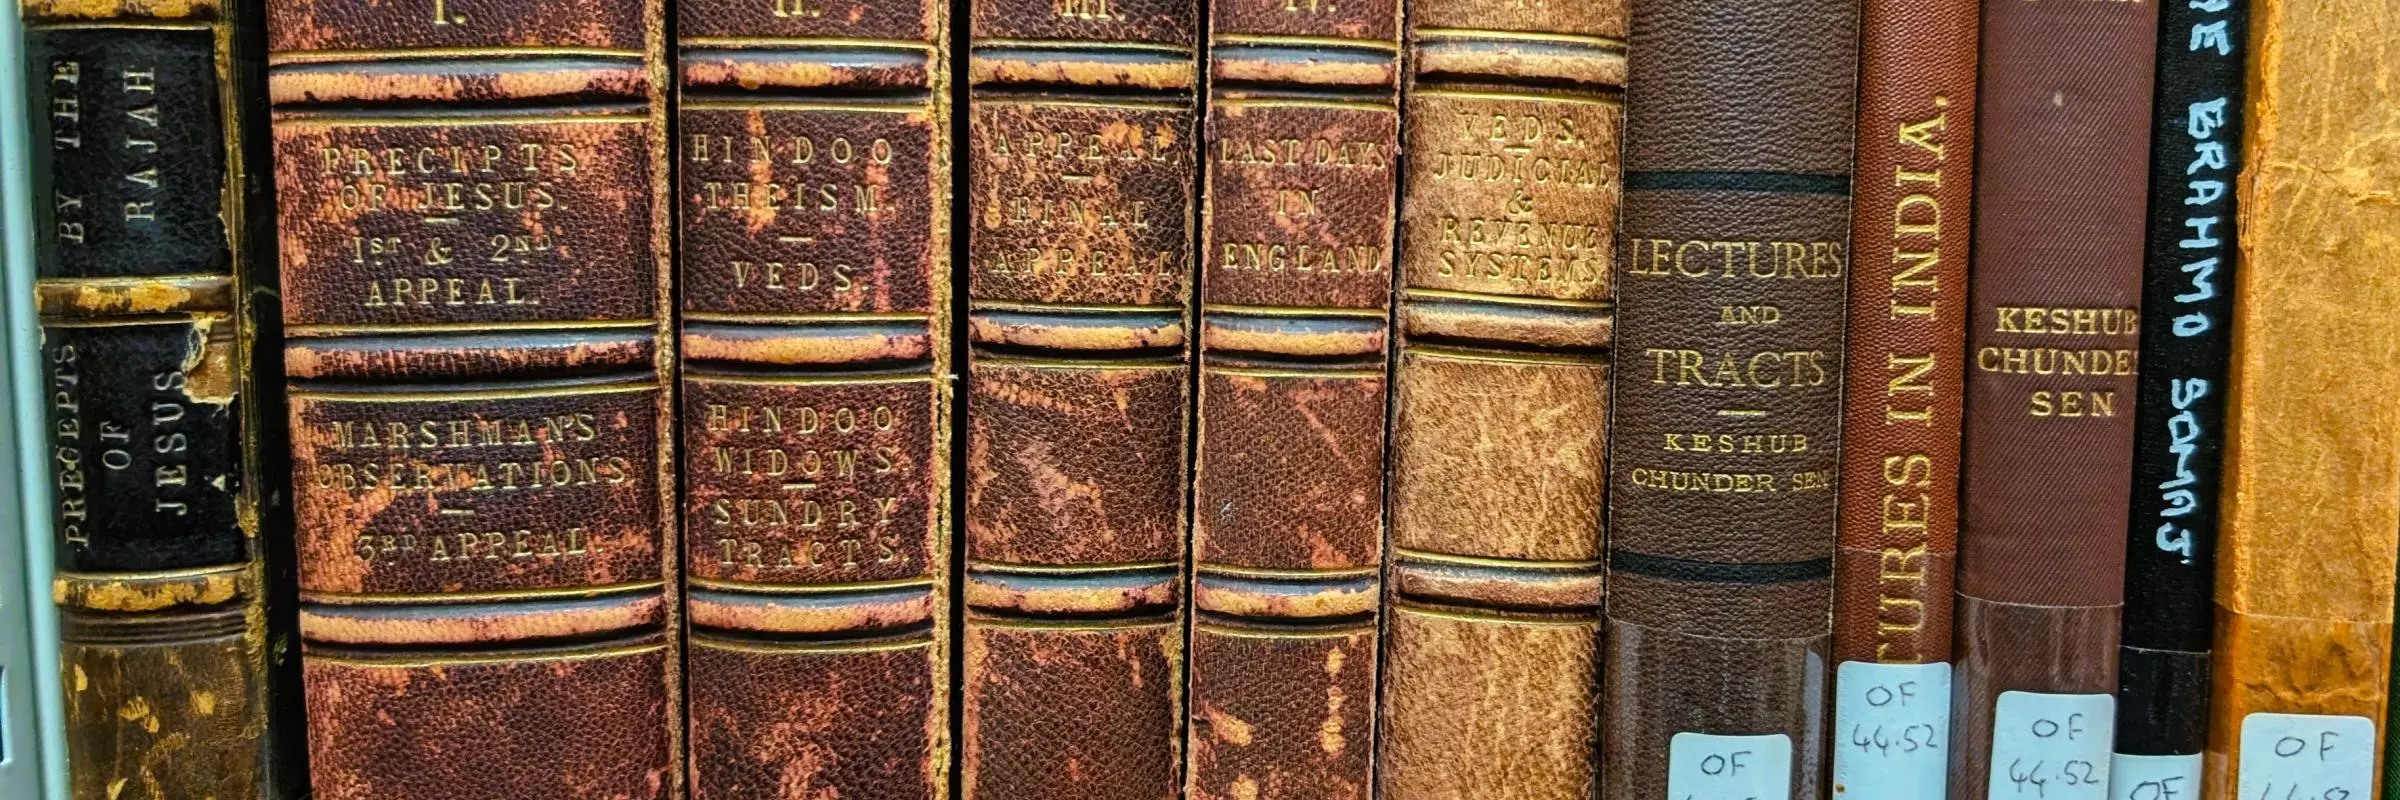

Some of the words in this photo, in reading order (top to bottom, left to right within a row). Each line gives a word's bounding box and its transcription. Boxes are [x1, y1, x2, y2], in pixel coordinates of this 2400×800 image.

[53, 61, 80, 150] THE
[123, 67, 158, 222] RAJAH
[692, 134, 893, 165] HINDOO
[1220, 139, 1301, 166] LAST
[1316, 140, 1385, 170] DAYS
[341, 184, 386, 211] OF
[420, 181, 569, 210] JESUS.
[1279, 190, 1319, 216] IN
[1505, 189, 1533, 216] &
[1890, 95, 1948, 321] INDIA.
[55, 189, 84, 244] BY
[2172, 97, 2227, 337] BRAHMO
[425, 238, 453, 265] &
[1438, 250, 1600, 283] SYSTEMS
[1629, 238, 1841, 280] LECTURES
[731, 260, 869, 291] VEDS.
[364, 278, 539, 306] APPEAL.
[1718, 305, 1781, 325] AND
[1995, 307, 2139, 335] KESHUB
[1646, 348, 1825, 388] TRACTS
[1885, 351, 1936, 428] IN
[2030, 391, 2115, 417] SEN
[332, 413, 596, 449] MARSHMAN'S
[707, 404, 894, 434] HINDOO
[54, 344, 88, 547] PRECEPTS
[100, 421, 131, 470] OF
[153, 371, 188, 516] JESUS
[1663, 433, 1809, 453] KESHUB
[1631, 467, 1777, 492] CHUNDER
[1792, 471, 1830, 493] SEN
[714, 497, 896, 527] SUNDRY
[717, 538, 910, 568] TRACTS.
[1866, 681, 1916, 706] OF
[1852, 723, 1938, 758] 44.52
[2032, 713, 2083, 741] OF
[2275, 731, 2339, 761] OF
[1701, 751, 1752, 777] OF
[2009, 758, 2099, 798] 44.52
